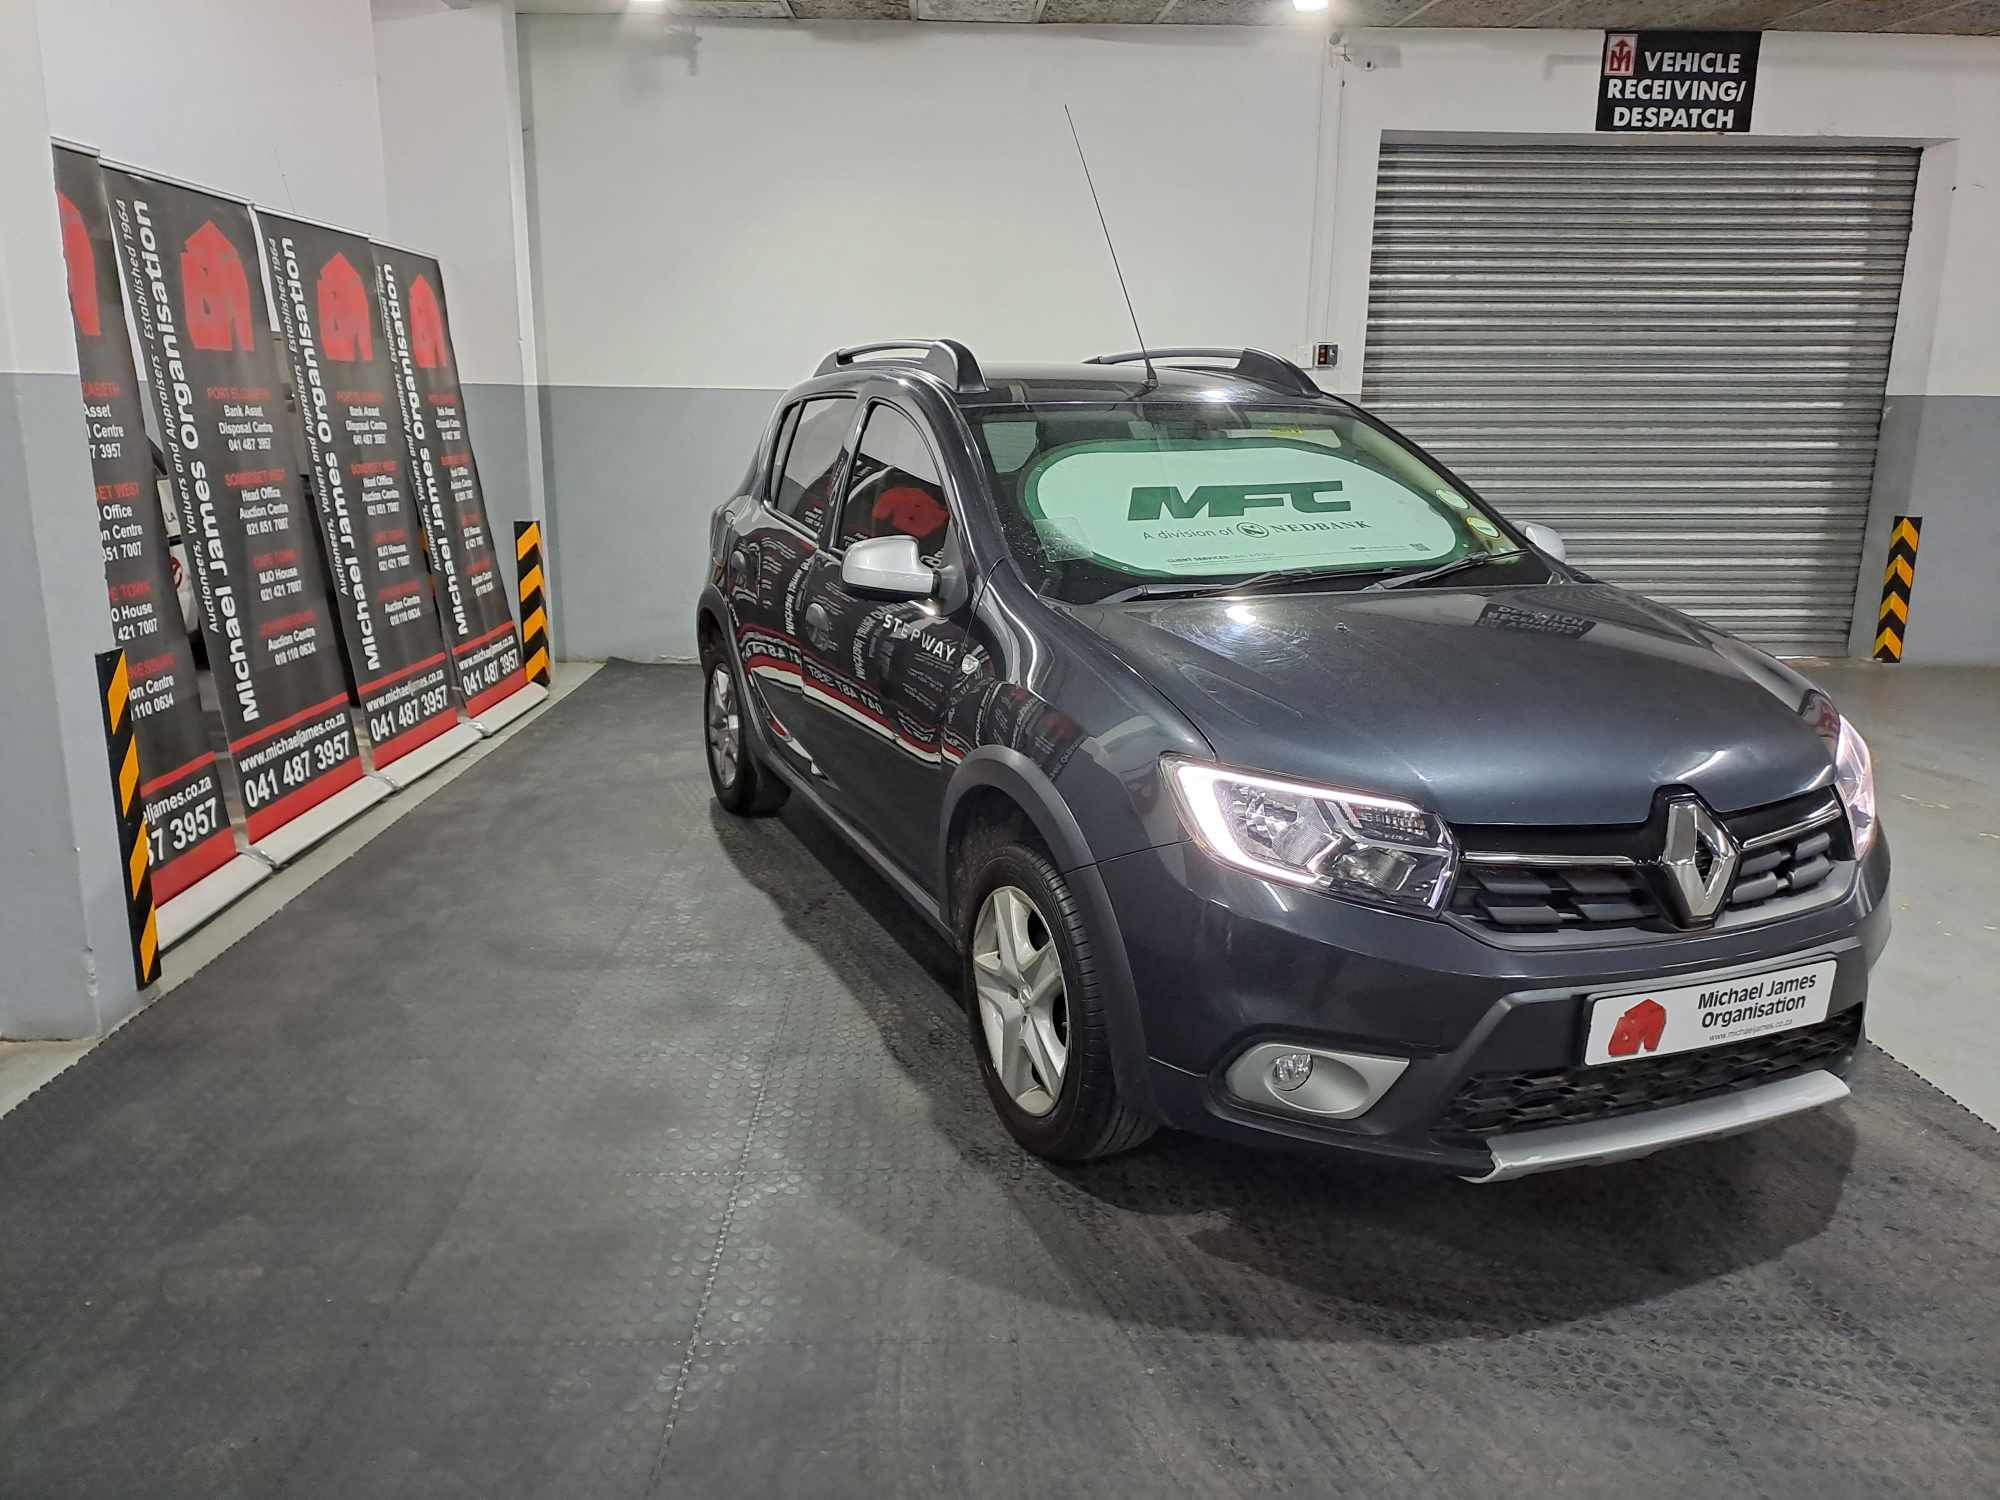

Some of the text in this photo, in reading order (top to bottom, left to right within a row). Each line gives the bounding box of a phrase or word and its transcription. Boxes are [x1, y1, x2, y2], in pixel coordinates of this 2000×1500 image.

[1644, 51, 1741, 74] VEHICLE
[1607, 79, 1746, 102] RECEIVING/
[1613, 106, 1735, 129] DESPATCH
[116, 199, 129, 240] 1964
[127, 246, 155, 339] Established
[384, 264, 425, 440] Organisation
[151, 355, 177, 439] Appraisers
[93, 423, 125, 438] Centre
[307, 436, 320, 462] and
[100, 443, 121, 458] 3957
[134, 201, 259, 722] Michael James Organisation
[168, 442, 184, 473] and
[282, 237, 380, 670] Michael James Organisation
[178, 478, 197, 534] Valuers
[315, 466, 331, 513] Valuers
[420, 448, 445, 531] James
[1128, 480, 1351, 521] MFC
[103, 504, 132, 520] Office
[1143, 520, 1372, 540] A division of NEDBANK
[112, 524, 143, 541] Centre
[120, 542, 142, 557] 7007
[193, 541, 220, 633] Auctioneers,
[437, 537, 469, 635] Michael
[118, 618, 158, 641] 421 7007
[121, 603, 152, 620] House
[883, 614, 956, 661] STEPWAY
[146, 674, 174, 693] Centre
[462, 648, 519, 695] 041 487 3957
[135, 702, 152, 720] 110
[153, 692, 174, 713] 0634
[371, 685, 448, 742] 041 487 3957
[245, 730, 350, 807] 041 487 3957
[170, 797, 217, 850] 3957
[1698, 974, 1817, 1010] Michael James
[1701, 995, 1806, 1028] Organisation
